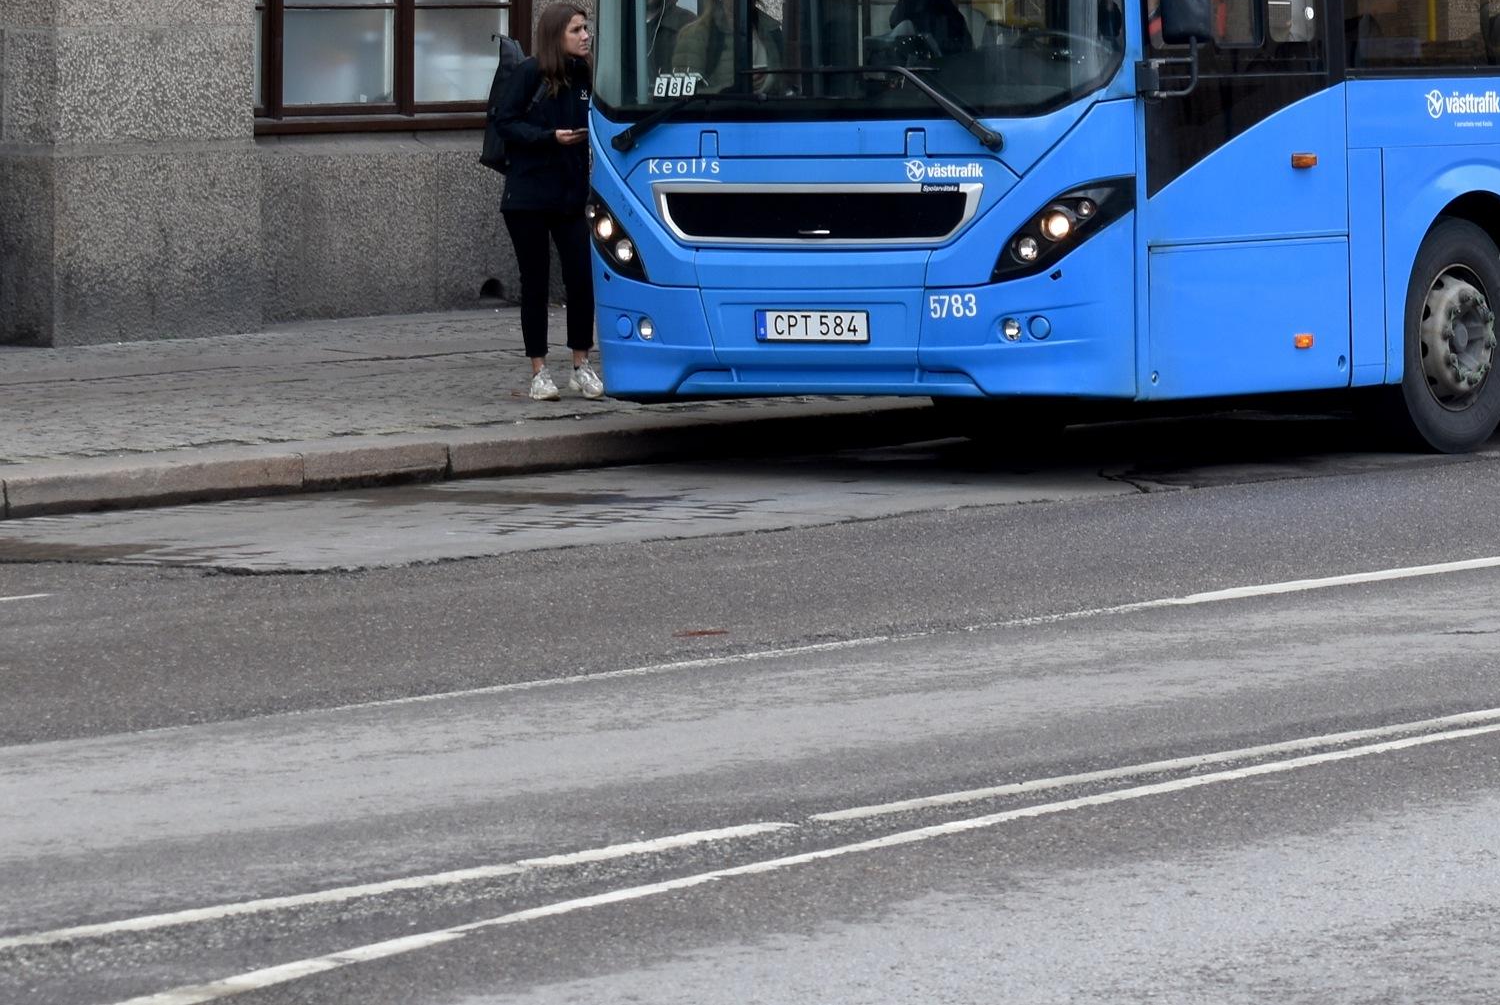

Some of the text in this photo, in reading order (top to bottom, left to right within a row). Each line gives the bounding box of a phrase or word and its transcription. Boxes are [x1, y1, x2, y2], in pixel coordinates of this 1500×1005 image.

[1445, 91, 1500, 114] västtrafik
[649, 159, 720, 174] Keolis
[927, 163, 984, 178] västtrafik
[929, 293, 977, 319] 5783
[773, 314, 859, 337] CPT 584
